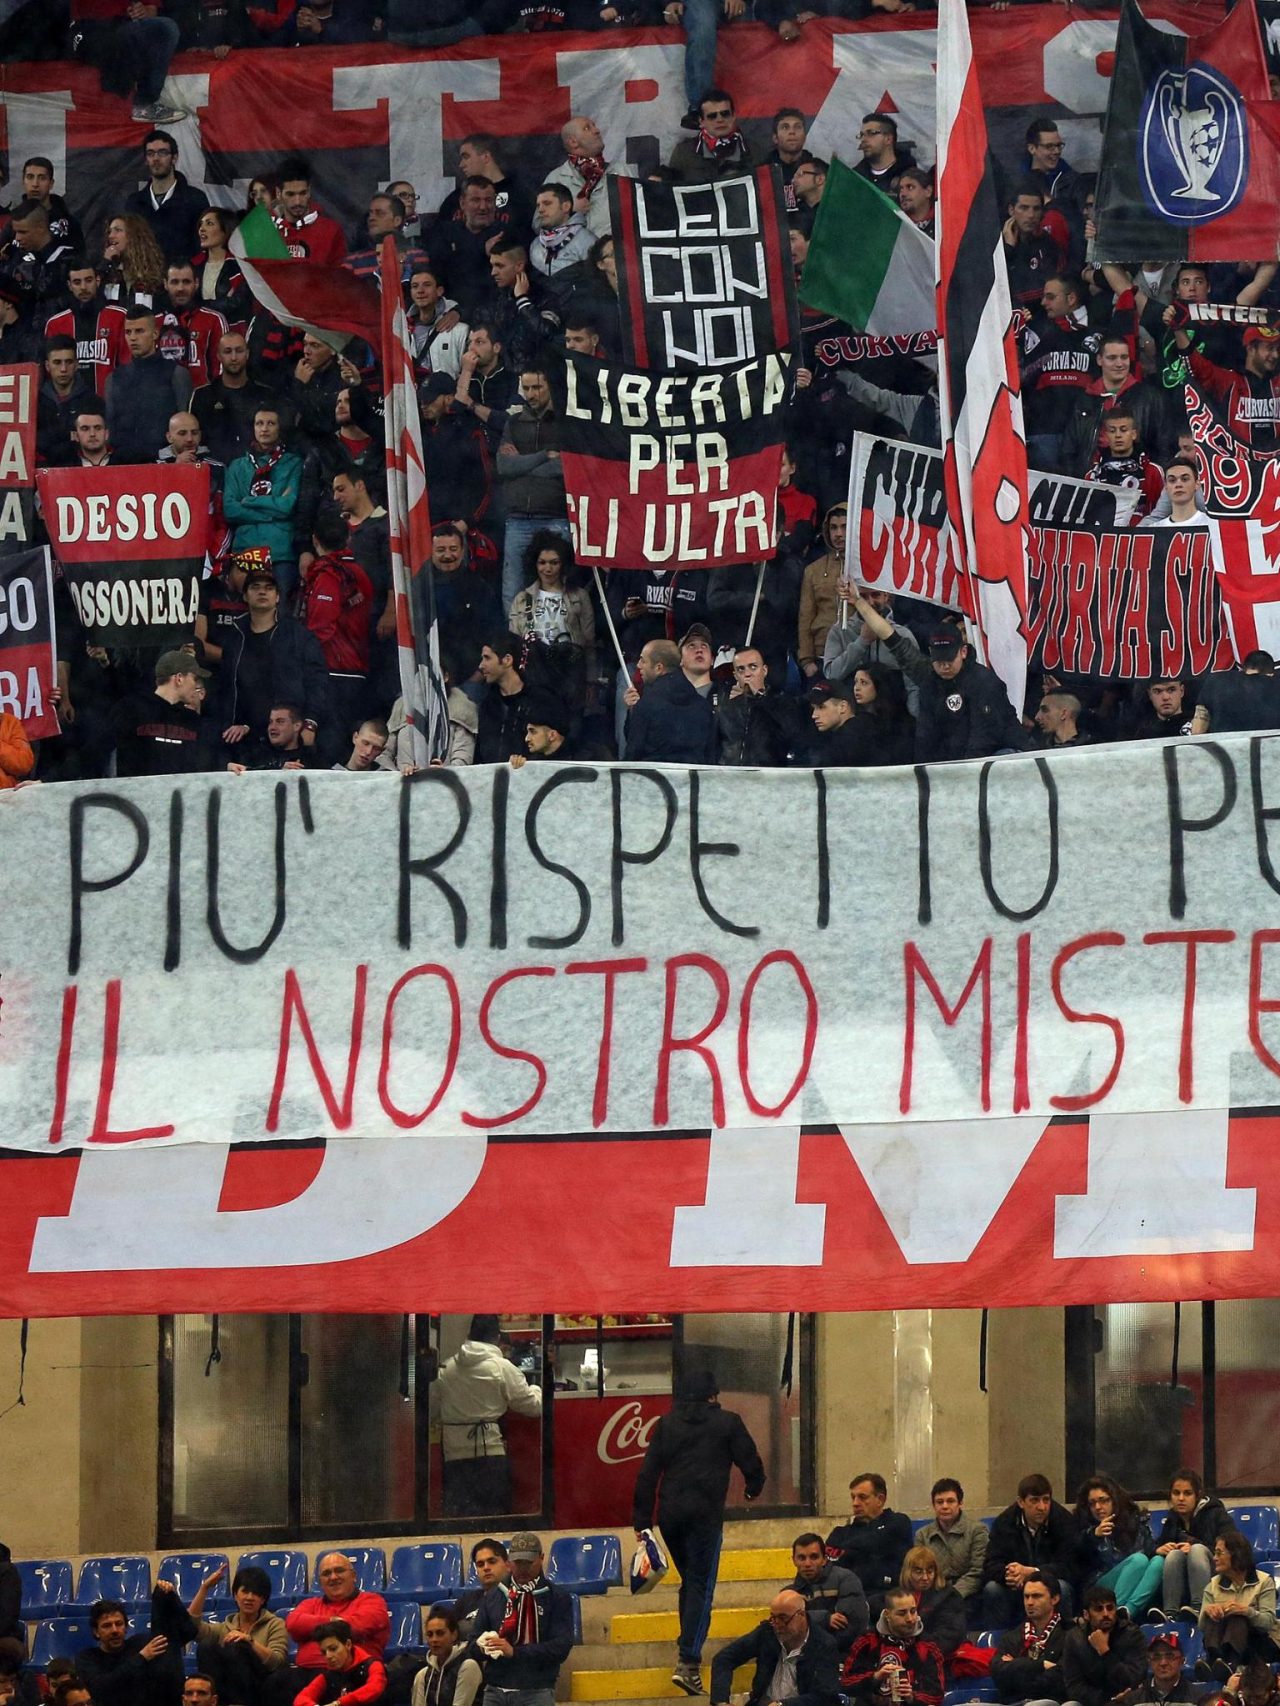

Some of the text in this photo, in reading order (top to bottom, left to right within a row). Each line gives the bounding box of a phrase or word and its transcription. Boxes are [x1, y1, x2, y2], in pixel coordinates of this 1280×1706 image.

[635, 175, 759, 239] LEO
[641, 241, 768, 303] CON
[662, 306, 756, 368] NOI
[1188, 303, 1268, 325] INTER
[629, 431, 730, 496] PER
[56, 492, 191, 543] DESIO
[642, 489, 778, 562] ULTRA
[66, 776, 315, 976] PIU'
[48, 979, 175, 1144] IL
[265, 949, 819, 1133] NOSTRO
